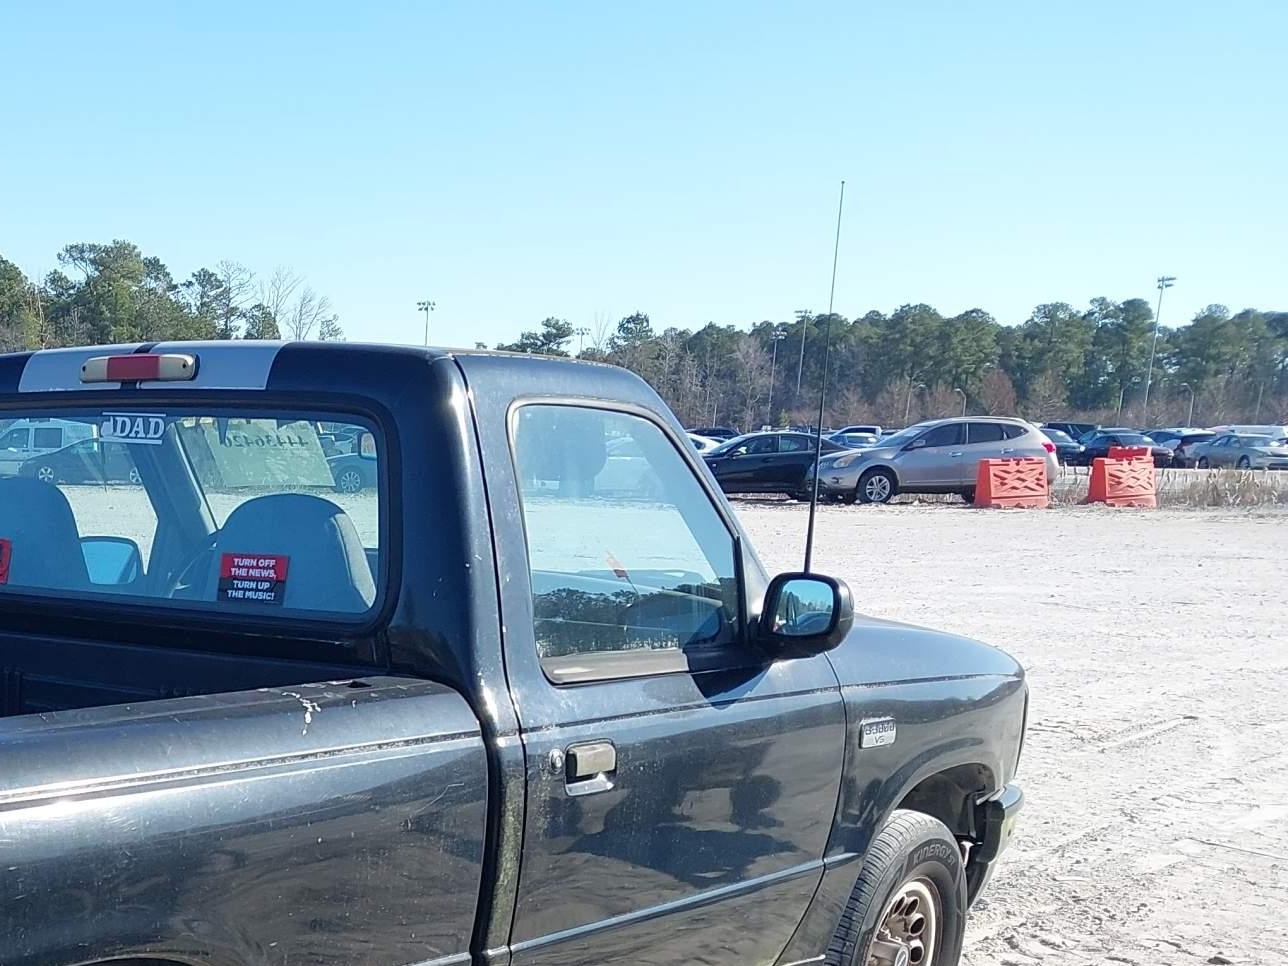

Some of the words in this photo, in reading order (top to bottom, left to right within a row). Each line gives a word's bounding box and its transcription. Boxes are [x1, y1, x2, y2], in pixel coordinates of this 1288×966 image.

[115, 416, 165, 438] DAD
[233, 558, 257, 567] TURN
[258, 559, 276, 568] OFF
[231, 567, 248, 576] THE
[248, 568, 277, 579] NEWS,
[233, 580, 257, 589] TURN
[257, 581, 270, 590] UP
[227, 590, 244, 598] THE
[245, 591, 275, 601] MUSIC!
[913, 844, 952, 865] KINERGY
